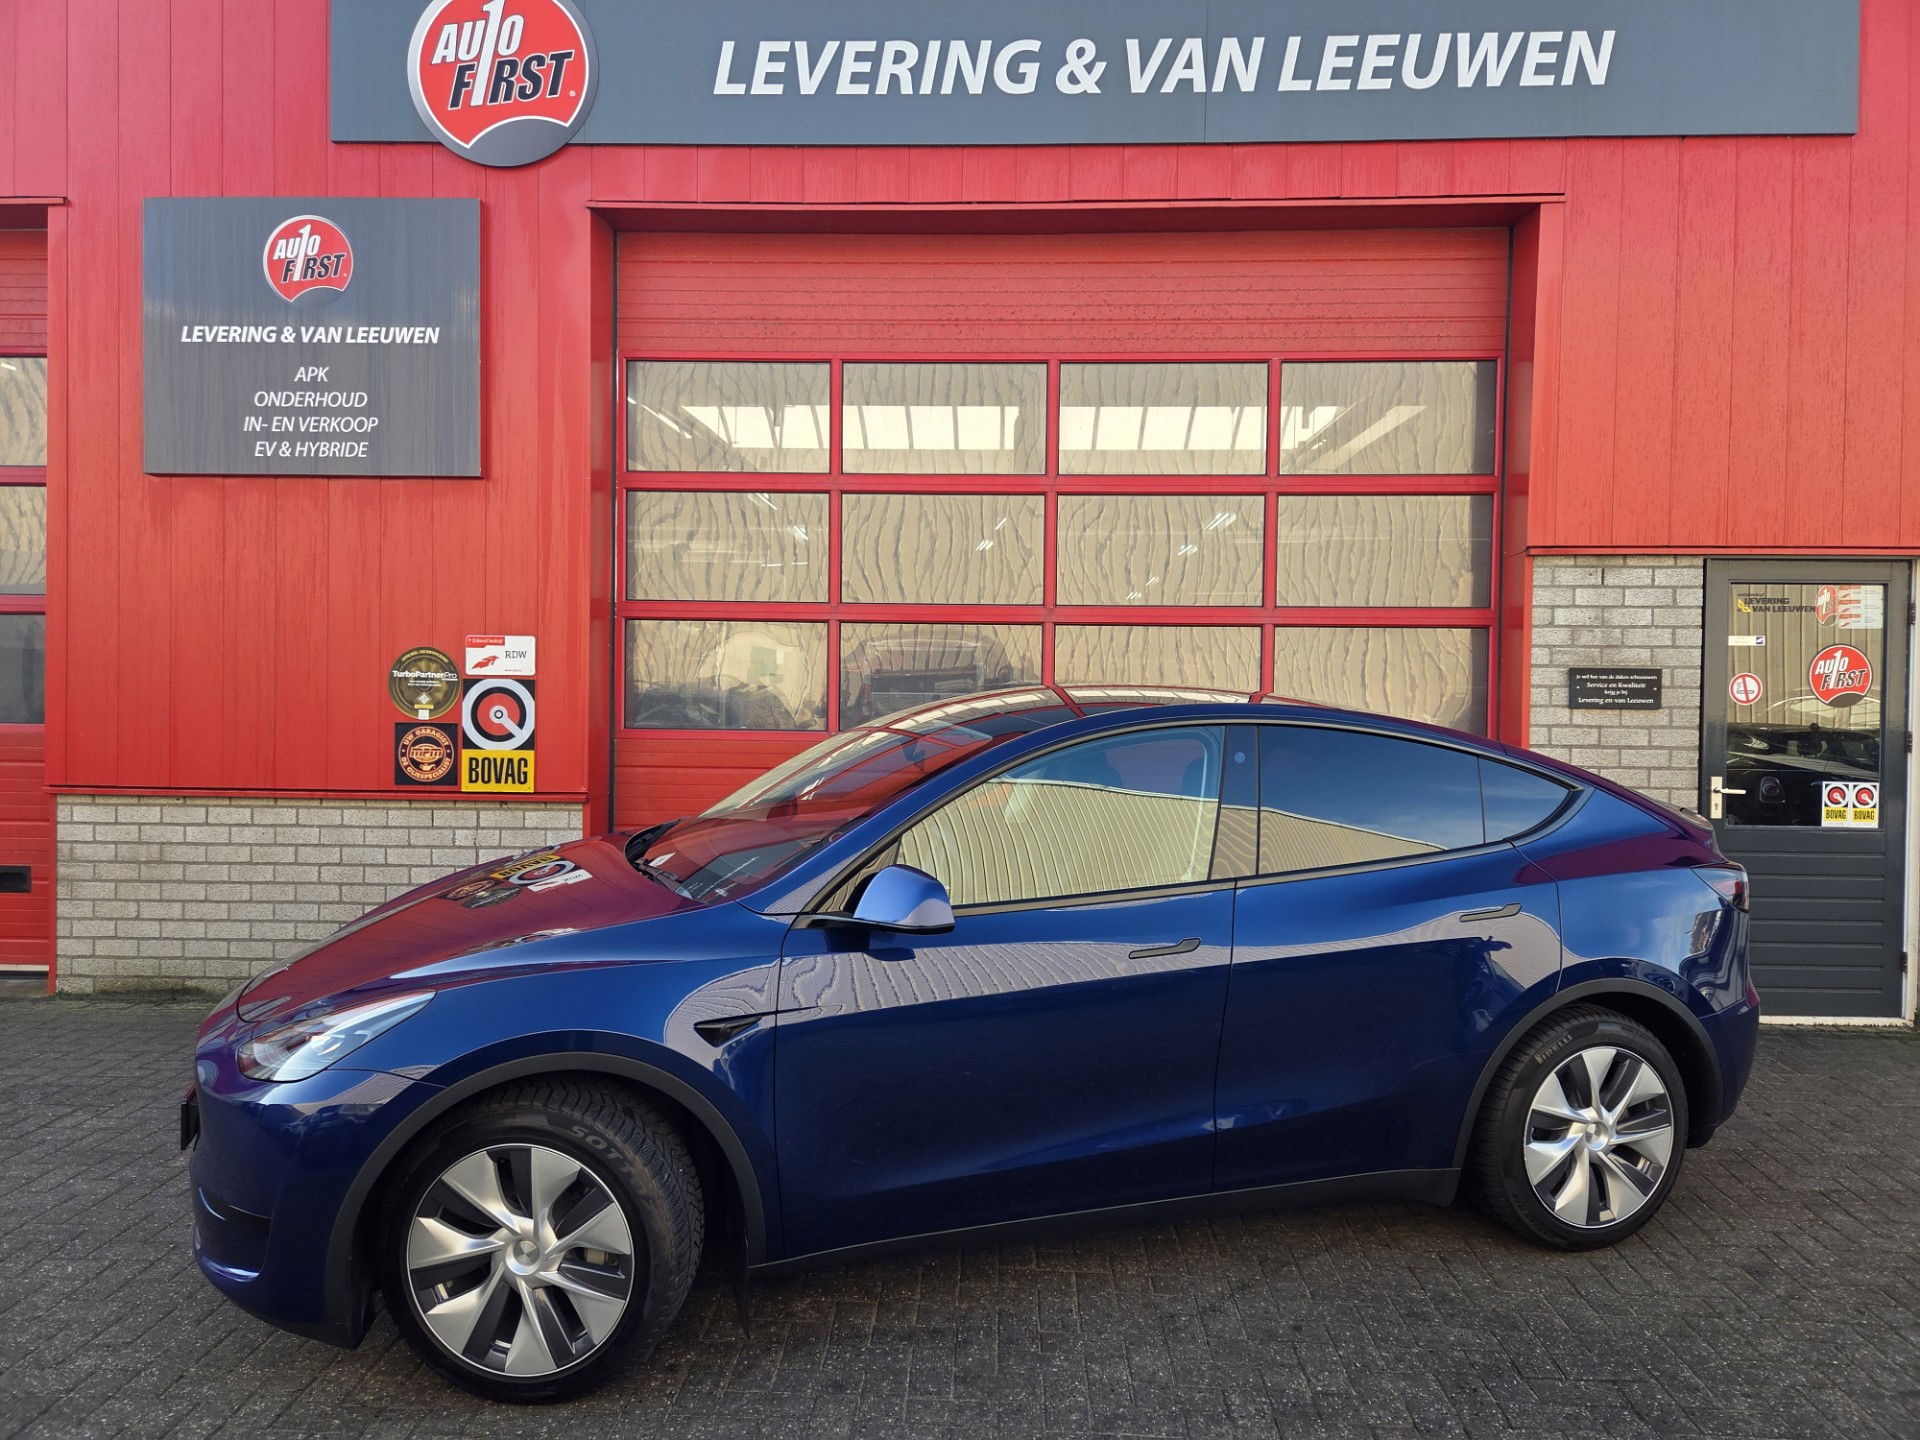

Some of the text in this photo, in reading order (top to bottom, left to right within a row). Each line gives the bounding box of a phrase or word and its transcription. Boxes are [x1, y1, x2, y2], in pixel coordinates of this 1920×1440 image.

[712, 30, 1616, 96] LEVERING & VAN LEEUWEN
[181, 326, 440, 344] LEVERING & VAN LEEUWEN
[294, 366, 329, 383] APK
[254, 391, 368, 408] ONDERHOUD
[243, 416, 378, 433] IN- EN VERKOOP
[254, 441, 368, 458] EV & HYBRIDE
[505, 650, 527, 659] RDW
[468, 757, 528, 785] BOVAG
[1825, 809, 1847, 819] BOVAG
[1853, 810, 1875, 820] BOVAG
